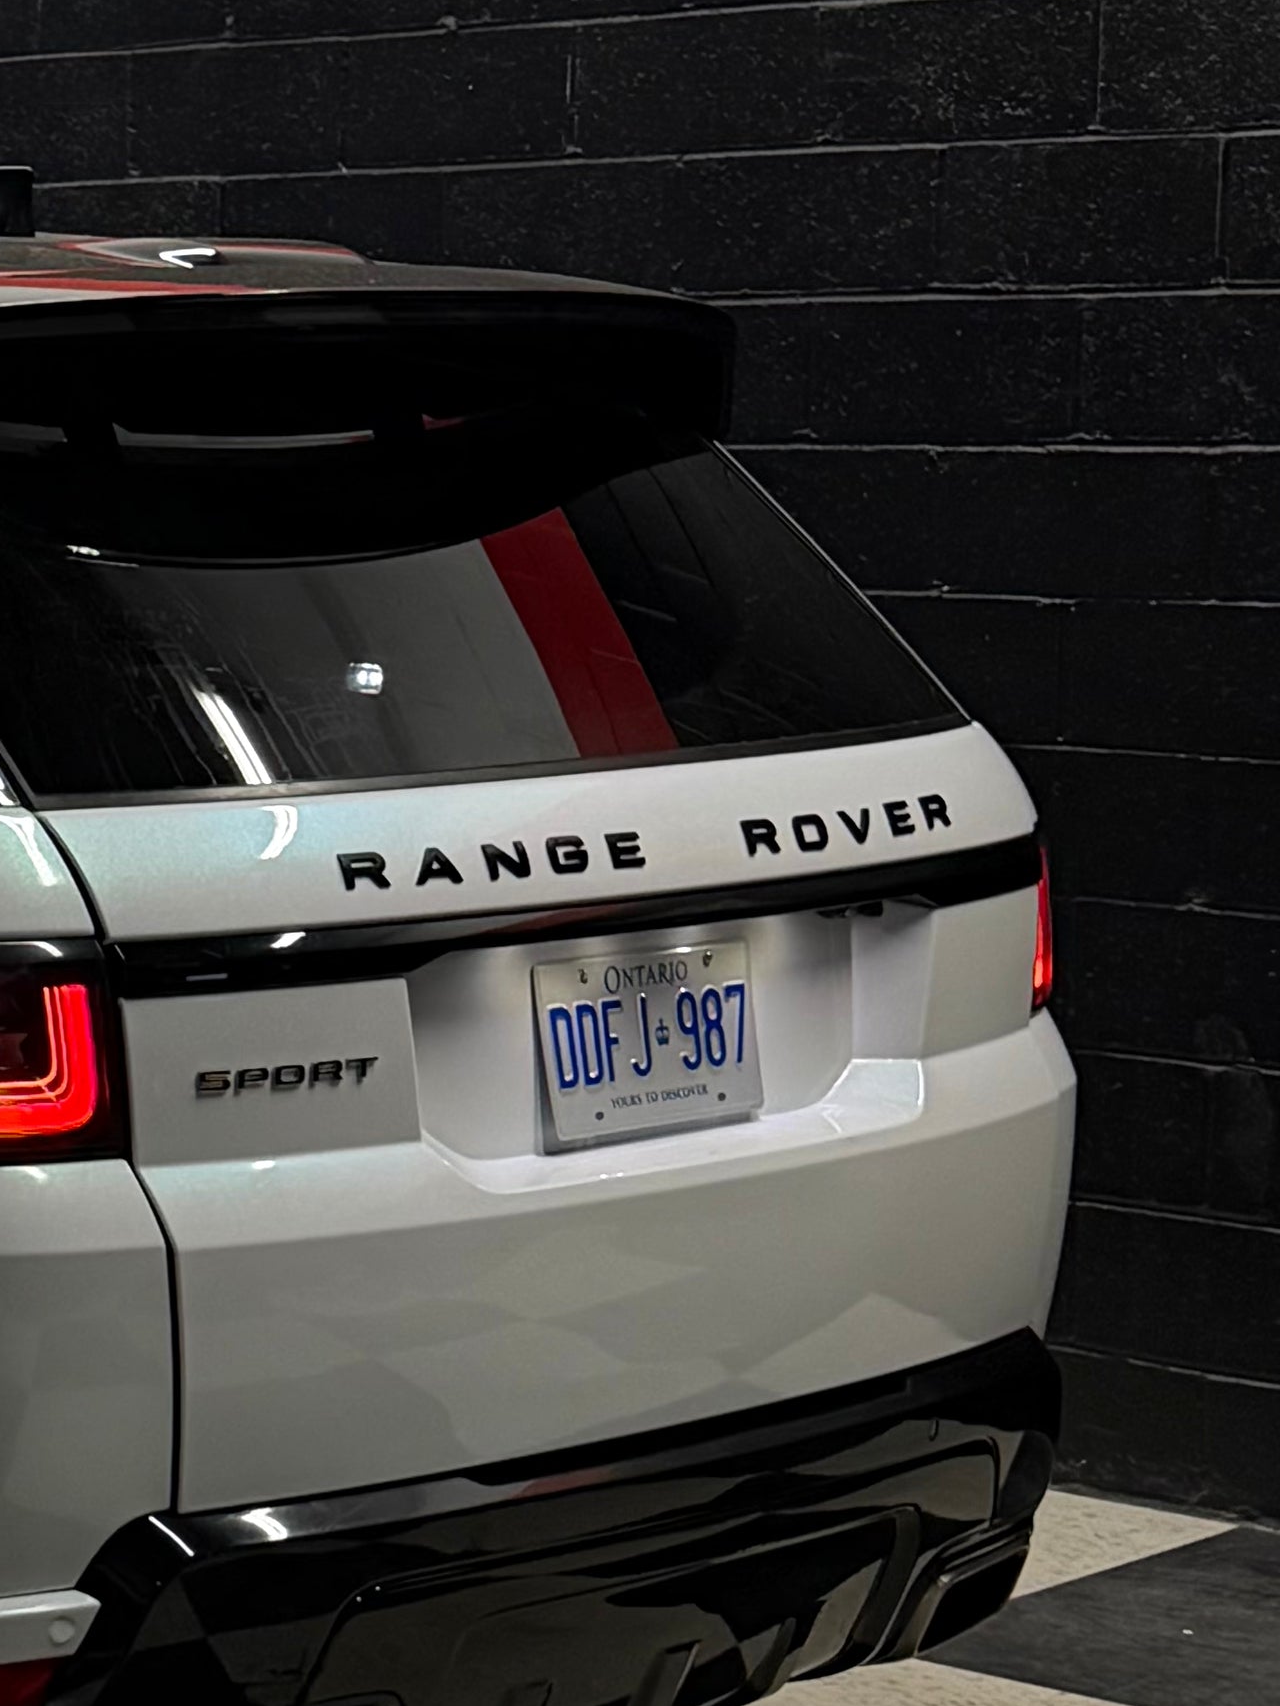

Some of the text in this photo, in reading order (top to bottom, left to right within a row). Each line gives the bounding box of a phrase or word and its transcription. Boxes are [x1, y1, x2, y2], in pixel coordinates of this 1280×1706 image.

[337, 794, 952, 891] RANGE ROVER
[604, 960, 688, 994] ONTARIO
[547, 980, 745, 1090] DDFJ 987
[195, 1057, 379, 1097] SPORT
[646, 1091, 658, 1104] TO
